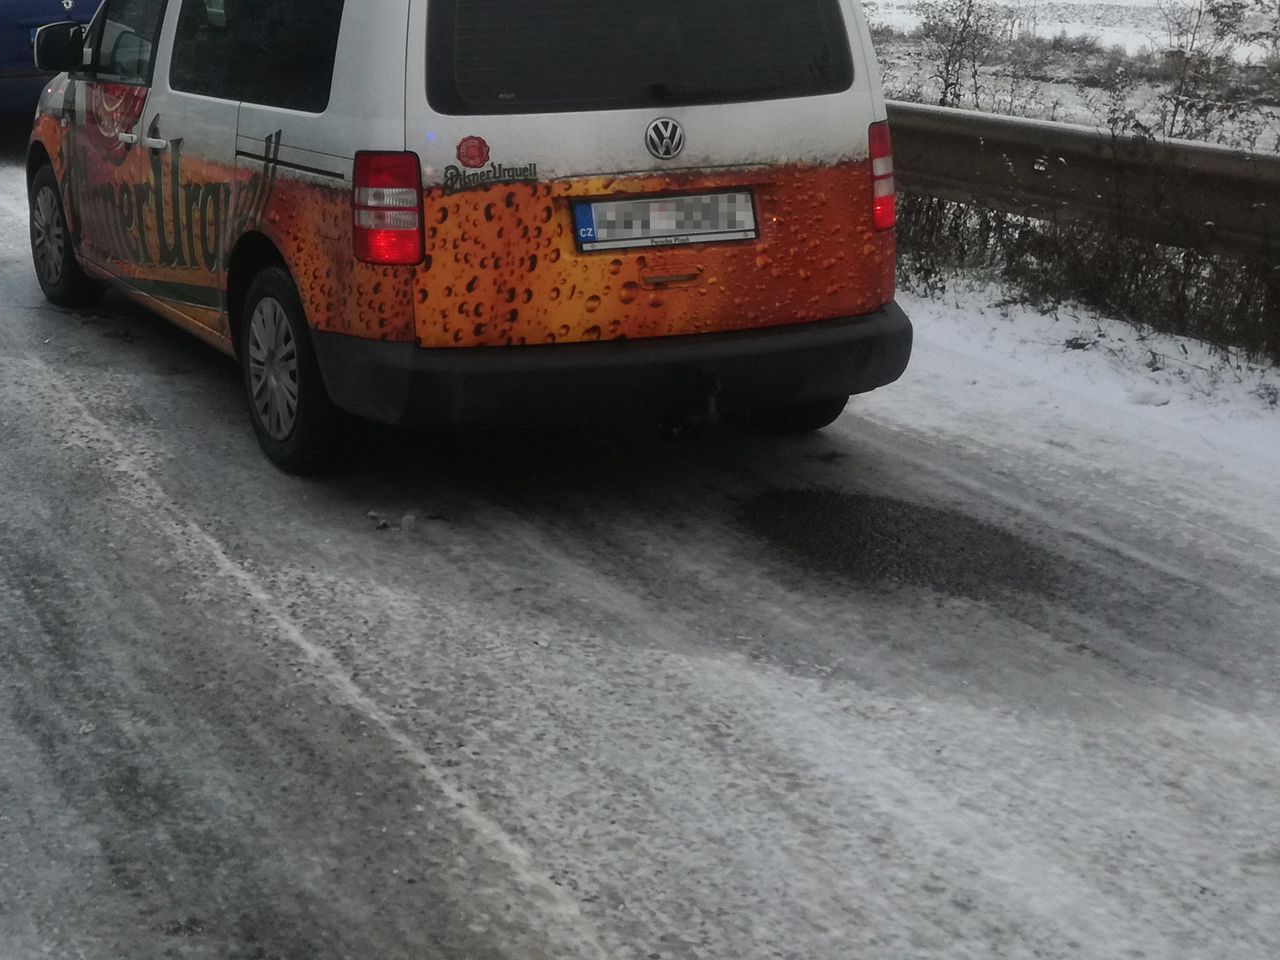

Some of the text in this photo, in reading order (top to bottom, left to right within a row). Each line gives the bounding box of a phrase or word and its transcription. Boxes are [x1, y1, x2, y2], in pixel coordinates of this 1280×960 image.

[444, 162, 537, 196] Pilsner Urquell
[580, 227, 594, 237] CZ
